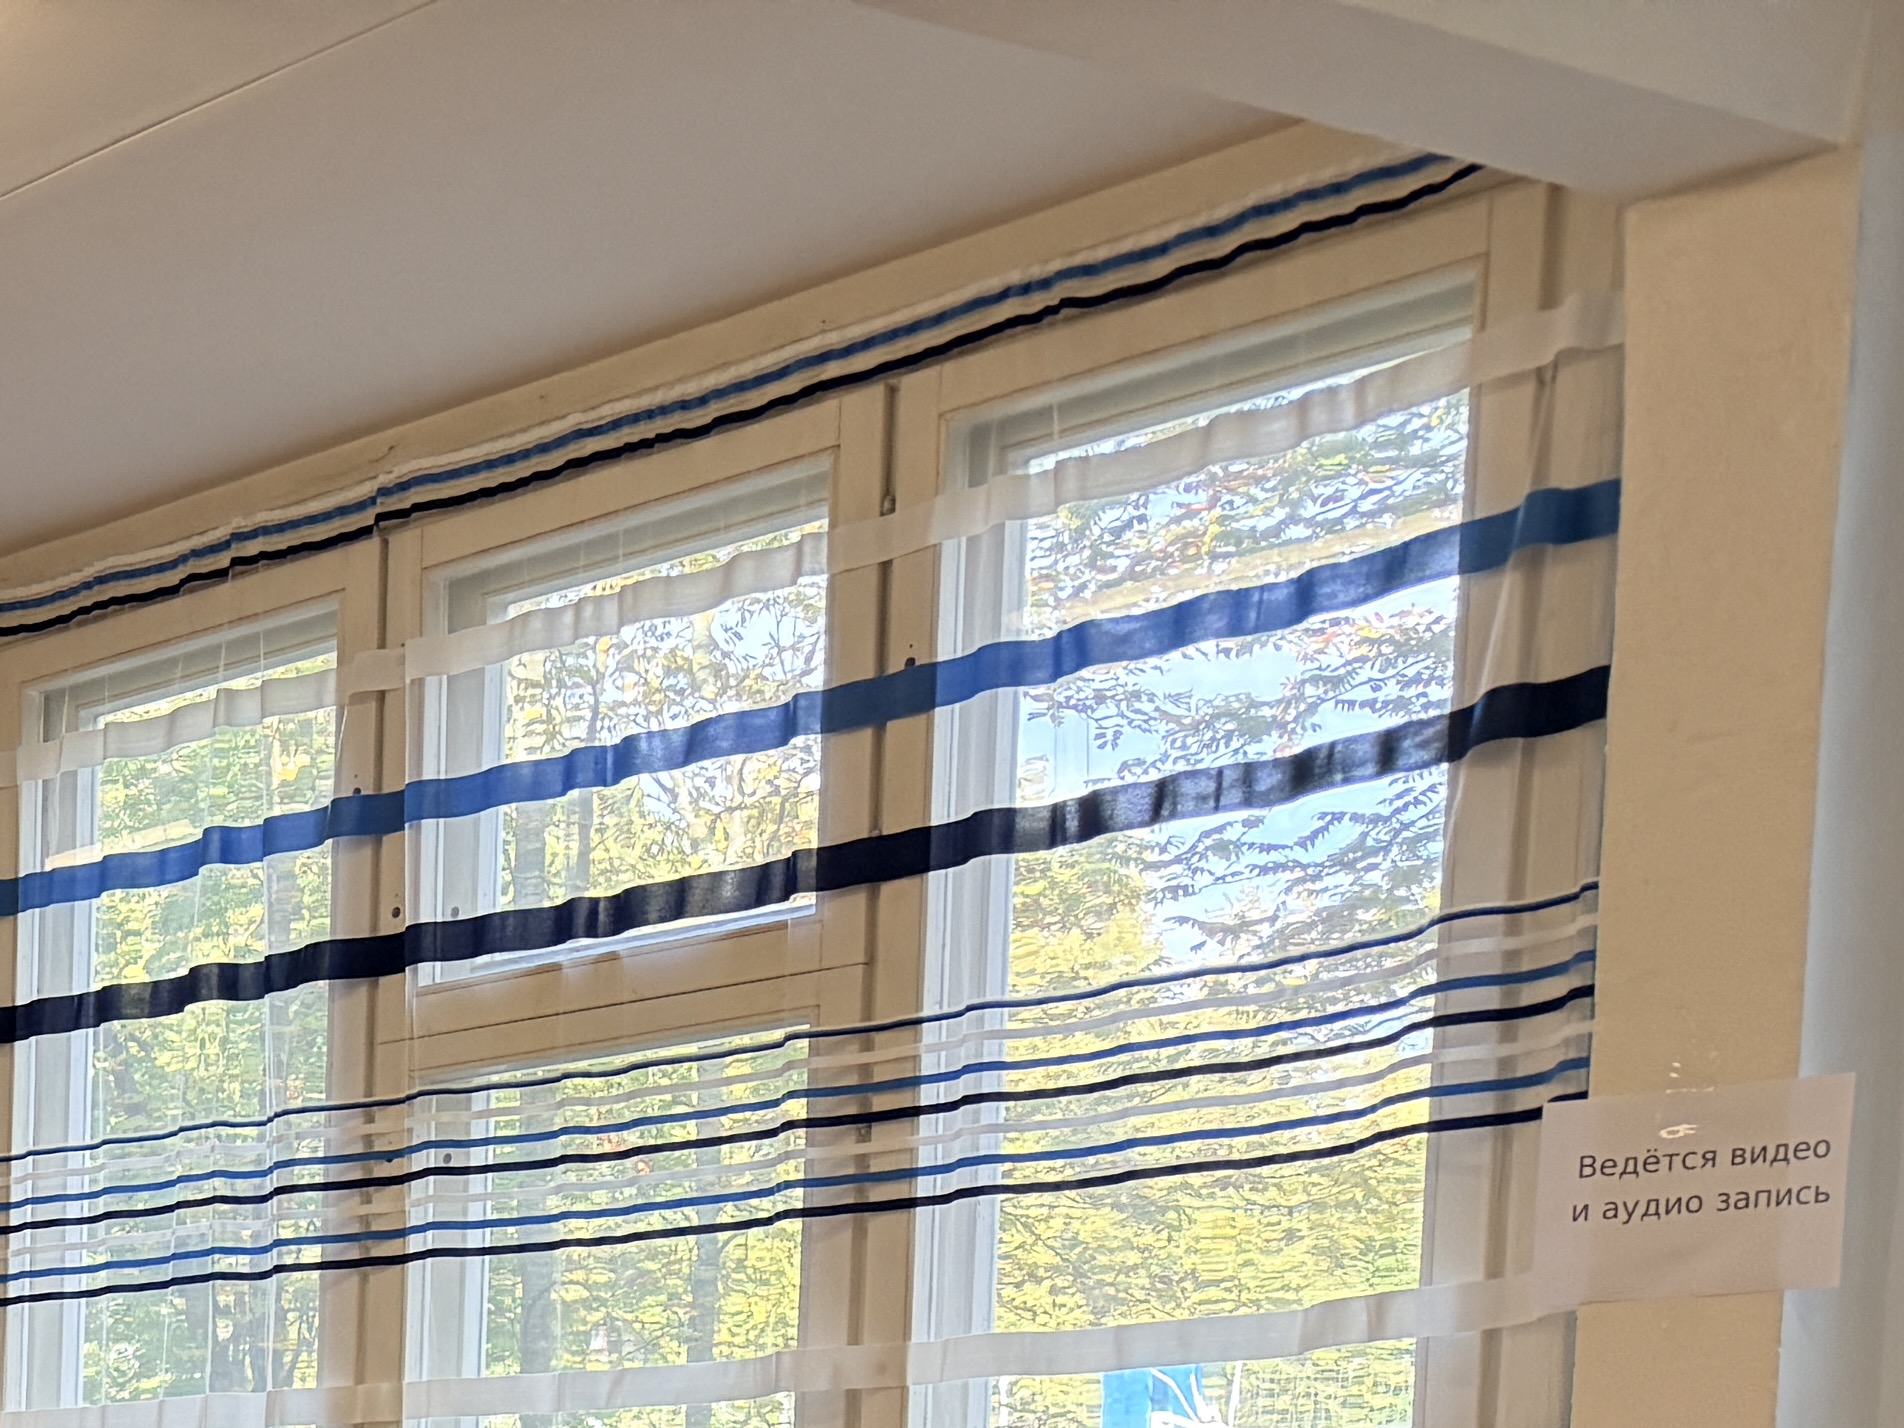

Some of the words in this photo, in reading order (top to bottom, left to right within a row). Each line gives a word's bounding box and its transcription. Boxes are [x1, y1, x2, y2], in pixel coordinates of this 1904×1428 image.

[1579, 1148, 1717, 1180] Ведётся
[1731, 1138, 1832, 1169] видео
[1572, 1203, 1590, 1222] и
[1602, 1194, 1703, 1226] аудио
[1716, 1184, 1831, 1213] запись
